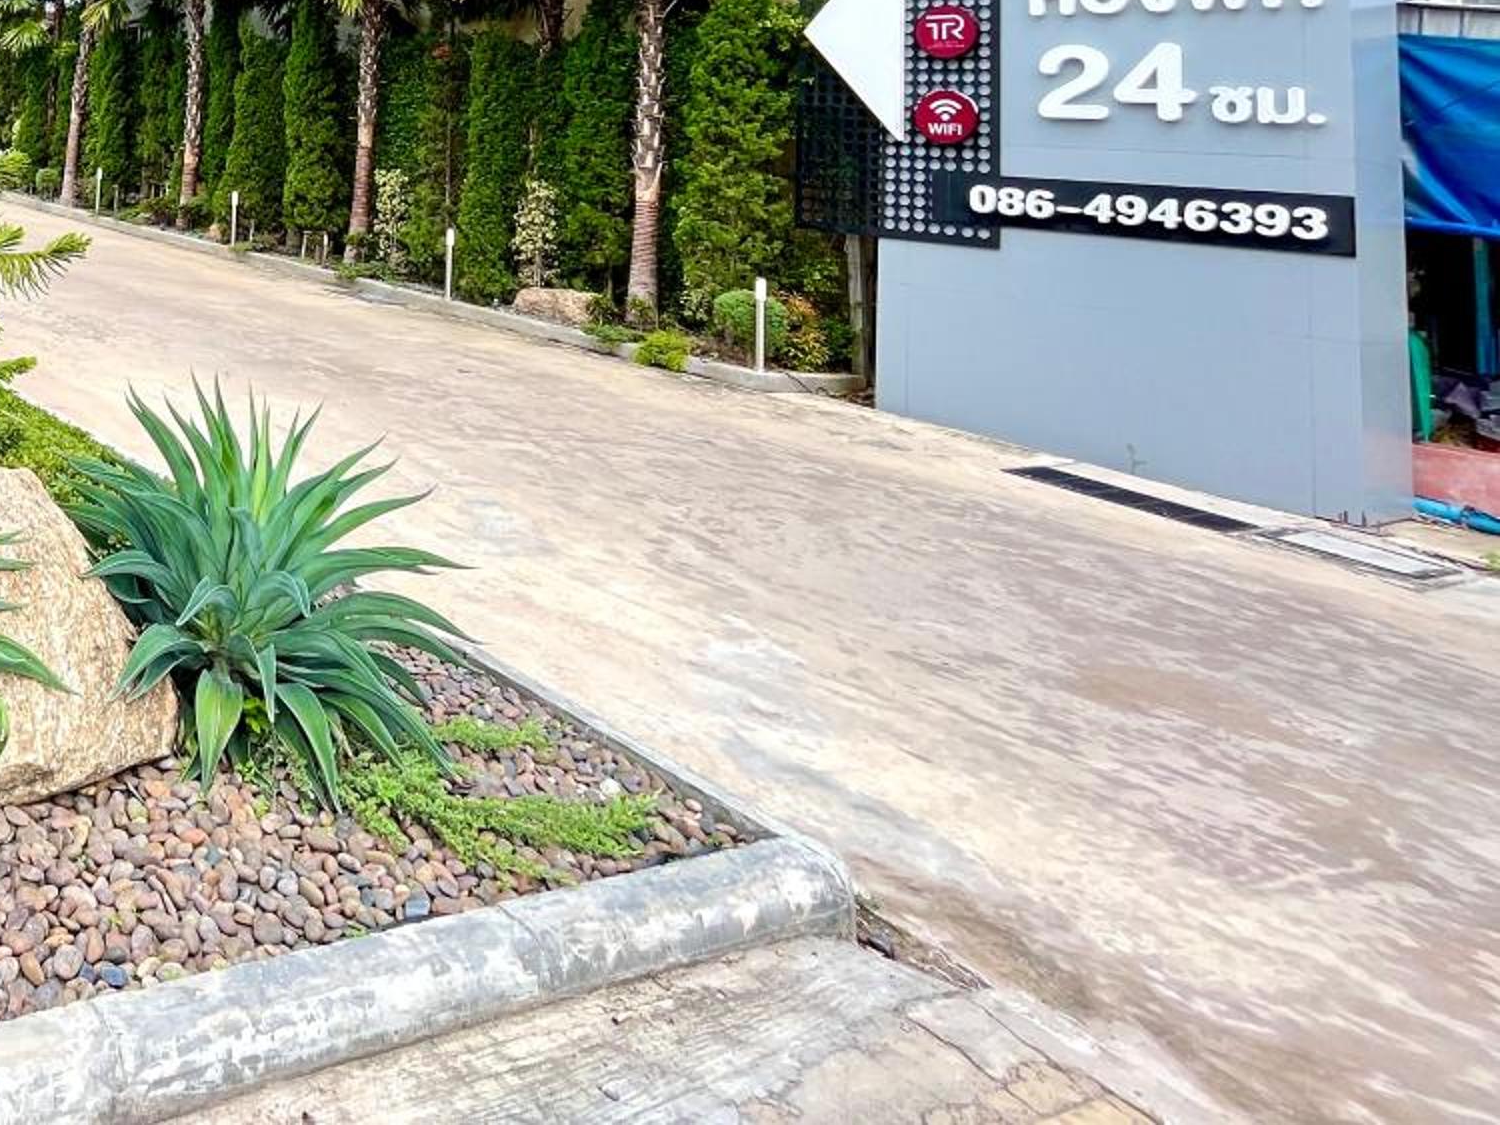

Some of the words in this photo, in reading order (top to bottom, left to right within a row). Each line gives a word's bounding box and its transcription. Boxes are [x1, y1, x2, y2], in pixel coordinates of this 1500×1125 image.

[1037, 42, 1198, 122] 24
[1209, 85, 1328, 125] ชม.
[927, 122, 963, 136] WIFI
[968, 184, 1329, 241] 086-4946393
